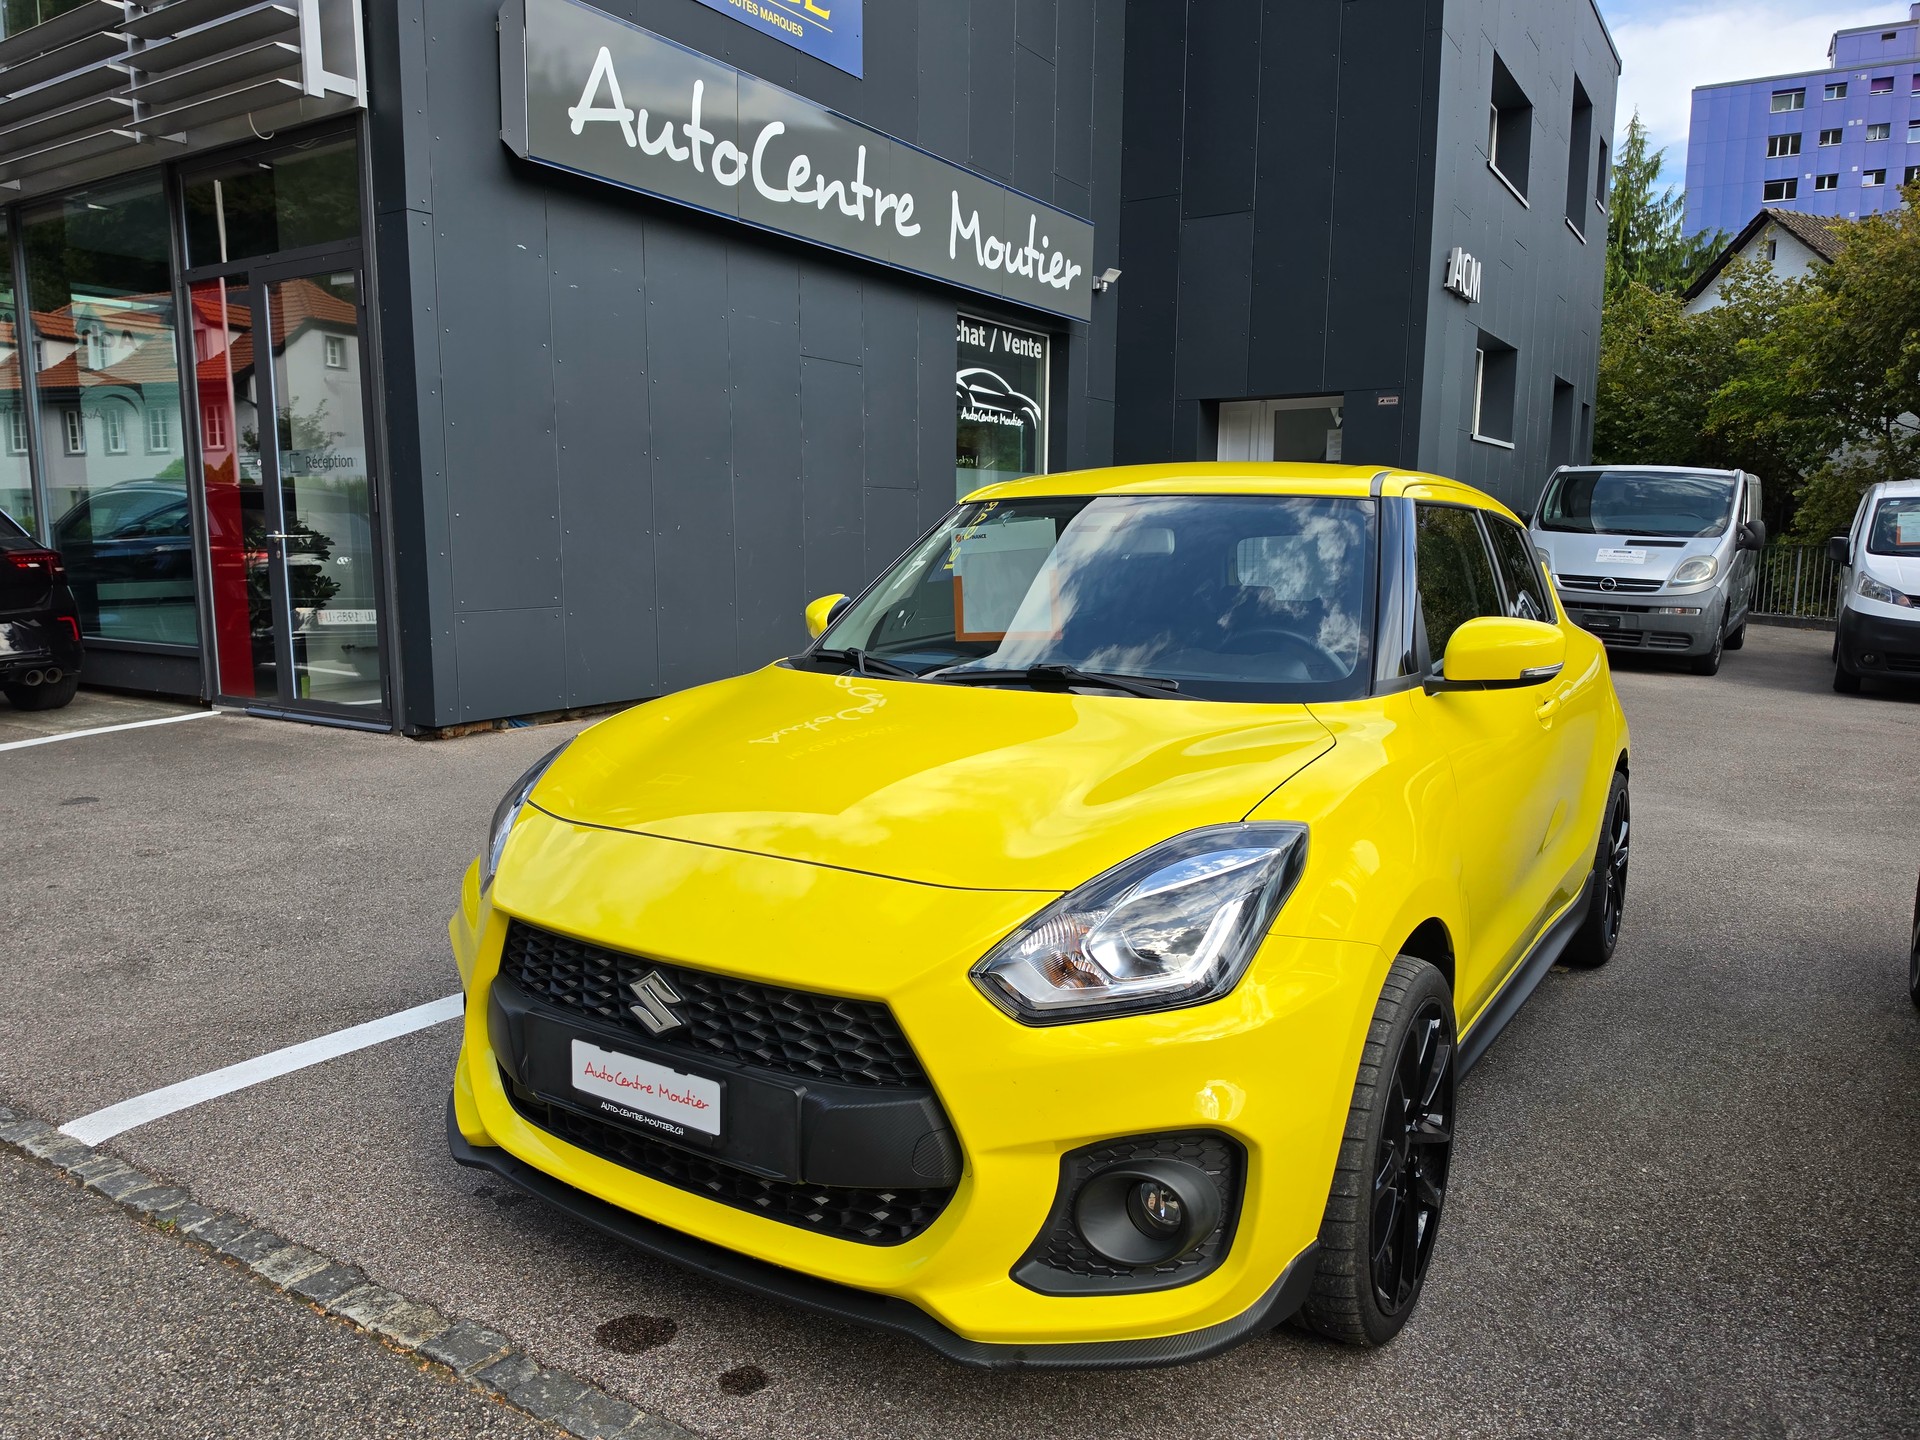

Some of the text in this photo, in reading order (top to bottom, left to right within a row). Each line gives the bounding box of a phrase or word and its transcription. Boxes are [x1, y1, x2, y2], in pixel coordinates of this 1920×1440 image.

[759, 6, 804, 37] MARQUES
[568, 46, 1082, 291] AutoCentre Moutier
[1450, 246, 1482, 304] ACM
[1002, 330, 1042, 359] Vente
[999, 412, 1024, 427] Moutier
[305, 454, 354, 471] Réception
[583, 1061, 710, 1110] AutoCentre Moutier
